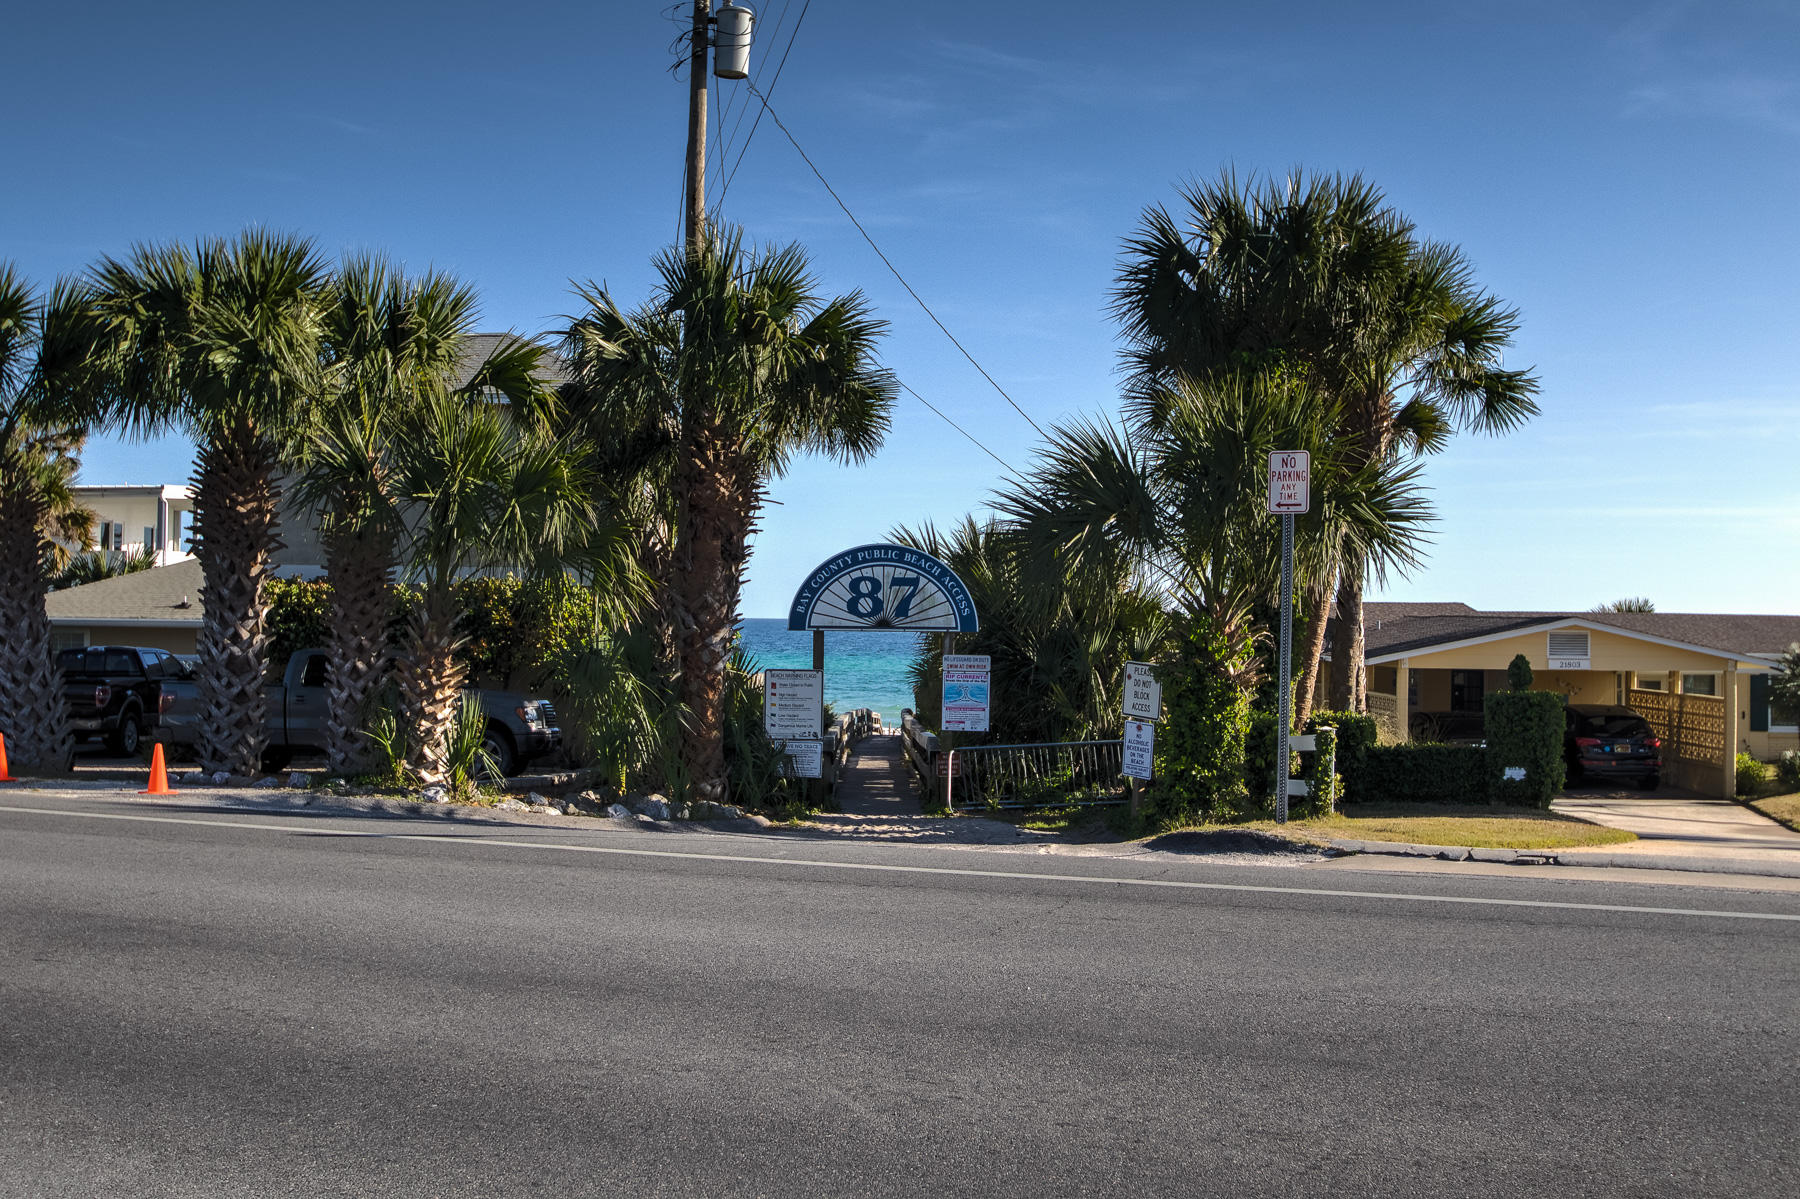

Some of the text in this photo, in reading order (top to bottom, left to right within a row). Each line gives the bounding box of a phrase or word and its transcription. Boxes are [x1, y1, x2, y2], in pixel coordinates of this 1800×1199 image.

[1281, 457, 1296, 468] NO
[1271, 470, 1306, 482] PARKING
[1280, 492, 1297, 500] TIME
[796, 549, 971, 616] BAY COUNTY PUBLIC BEACH ACCESS
[846, 575, 921, 618] 87
[1133, 678, 1152, 689] DO NOT
[1133, 690, 1150, 700] BLOCK
[1131, 702, 1151, 713] ACCESS
[1128, 739, 1150, 747] ALCOHOLIC
[1126, 745, 1150, 753] BEVERAGES
